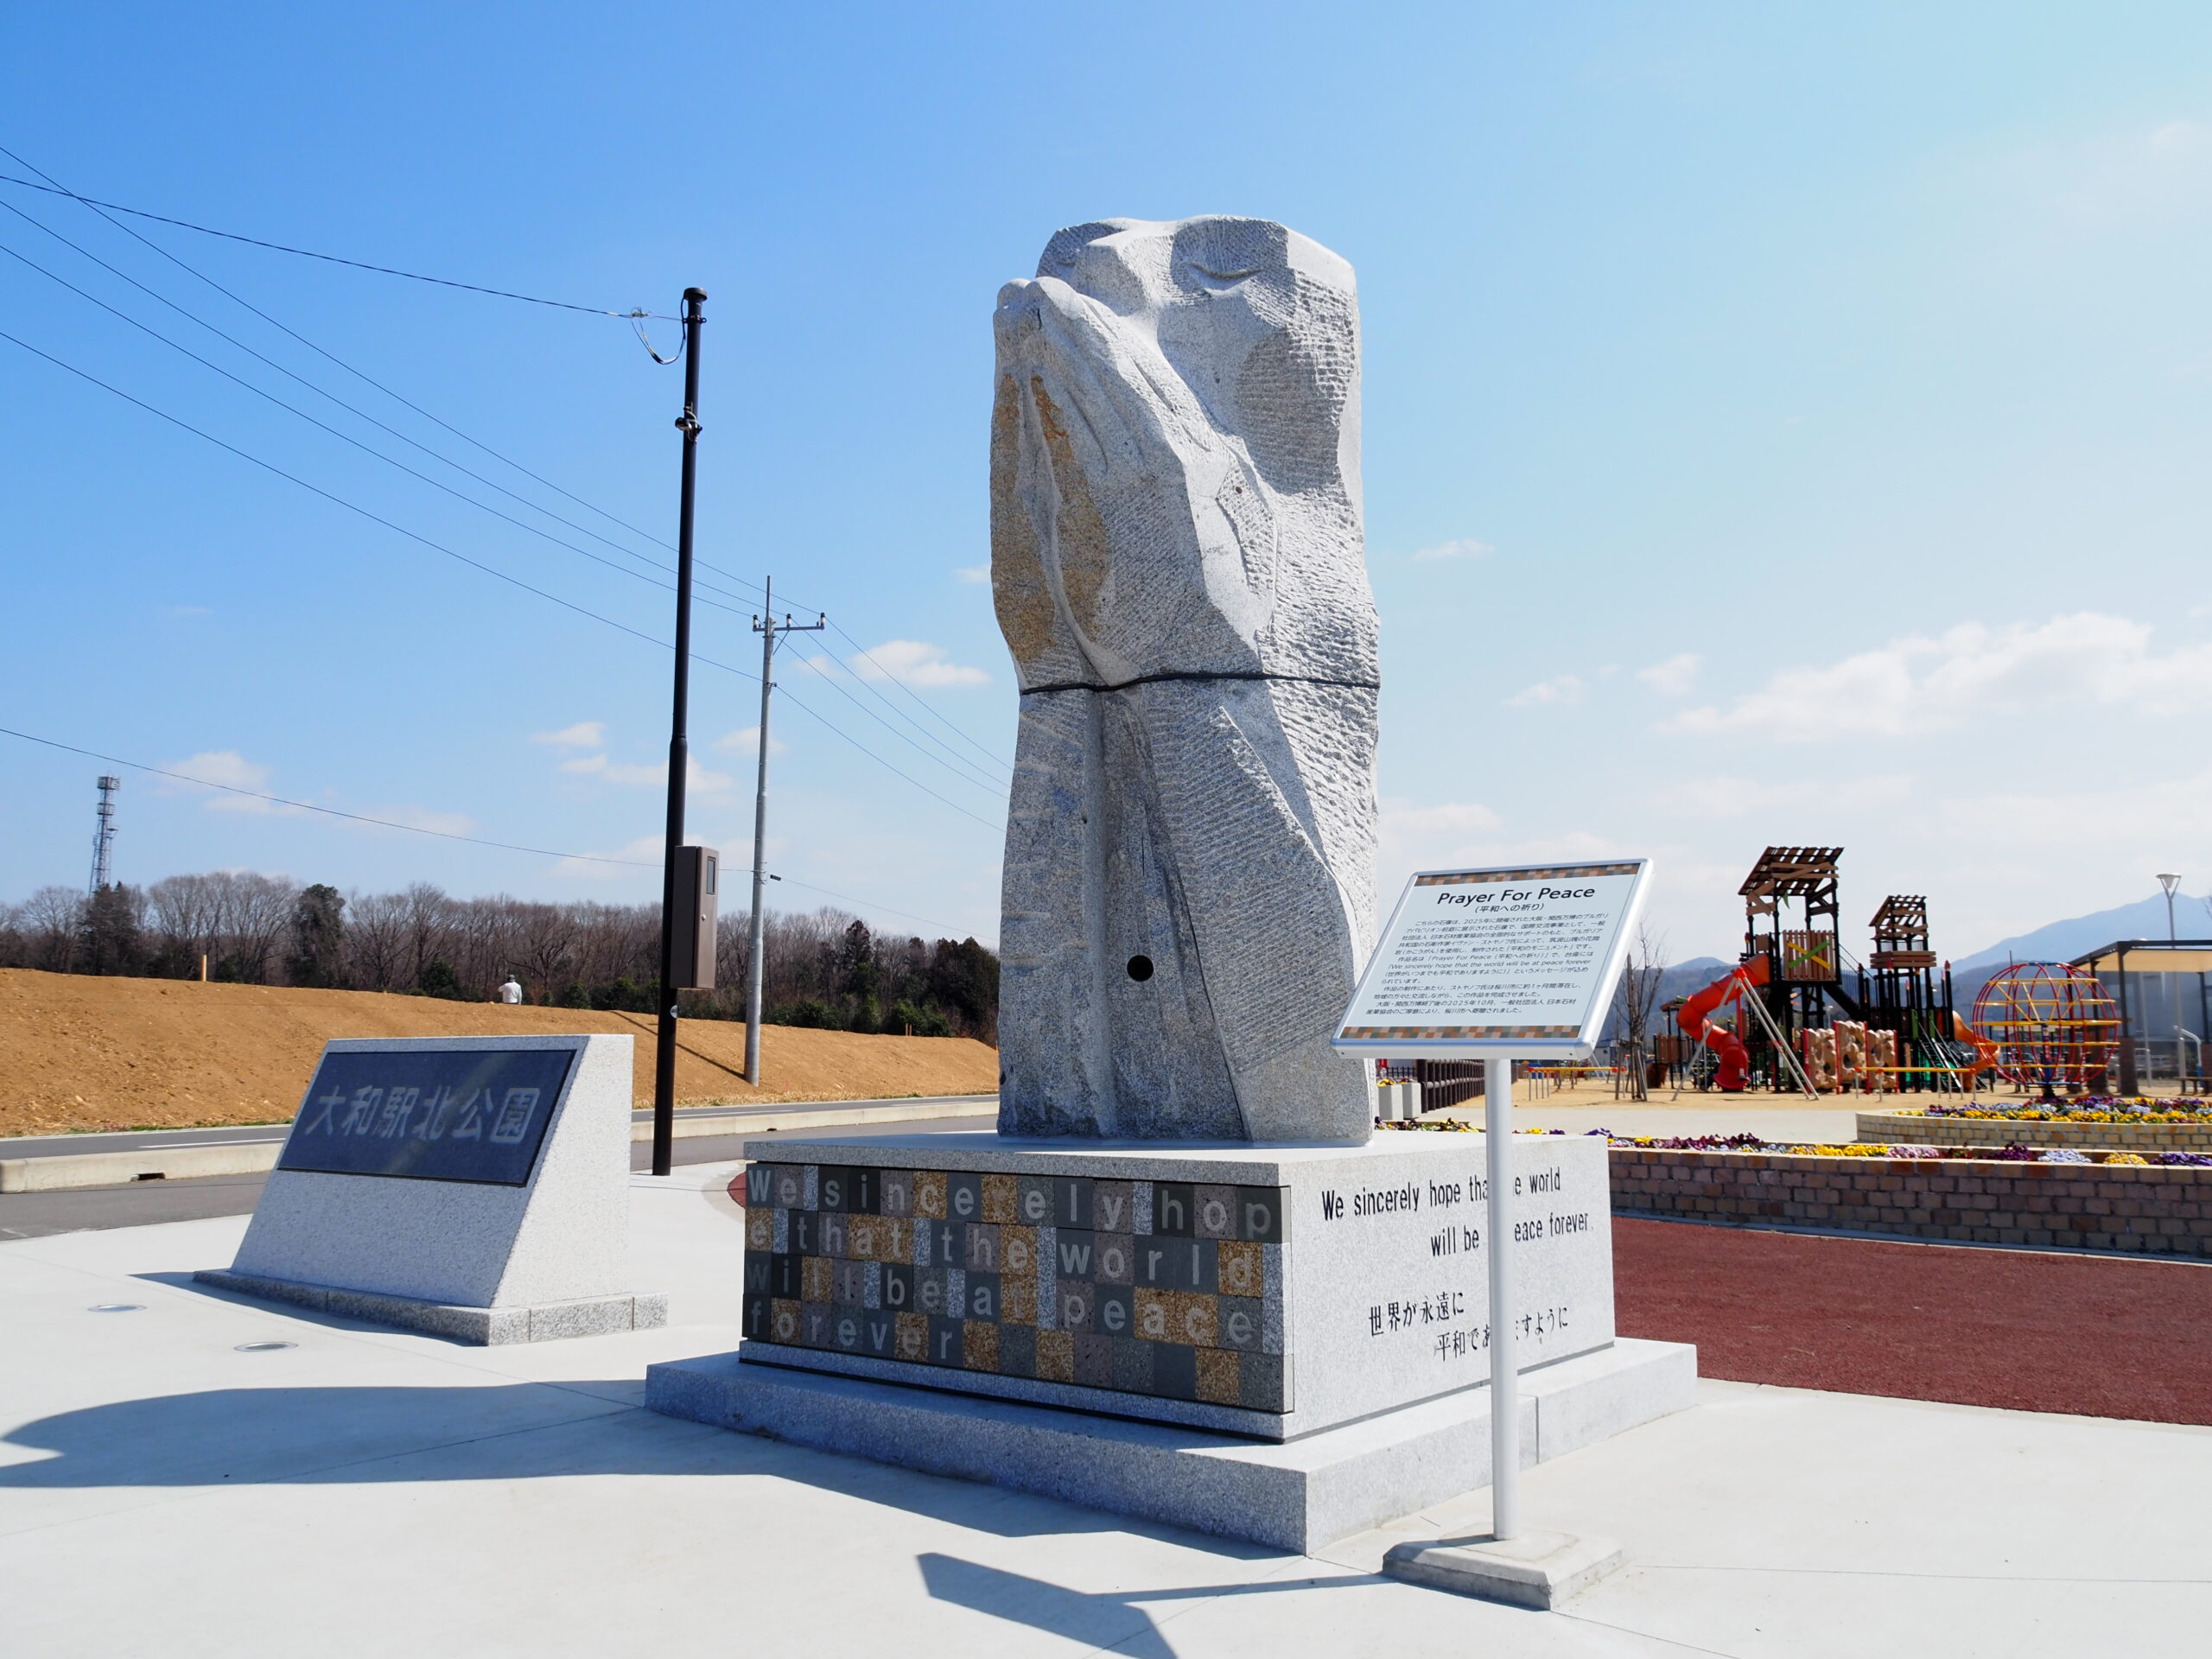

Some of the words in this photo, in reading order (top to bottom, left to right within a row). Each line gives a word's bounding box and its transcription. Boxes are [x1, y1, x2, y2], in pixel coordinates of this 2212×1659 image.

[1436, 892, 1497, 908] Prayer
[1500, 889, 1533, 902] For
[1537, 887, 1596, 900] Peace
[1474, 902, 1545, 914] （平和への祈り）
[305, 1084, 540, 1145] 大和駅北公園
[748, 1169, 797, 1205] We
[824, 1173, 1124, 1230] sincerely
[1161, 1190, 1271, 1238] hop
[1322, 1190, 1344, 1221] We
[1354, 1182, 1420, 1216] sincerely
[1430, 1179, 1460, 1208] hope
[1469, 1174, 1488, 1202] tha
[1529, 1166, 1560, 1194] world
[797, 1216, 901, 1258] that
[941, 1226, 1028, 1268] the
[1060, 1243, 1252, 1288] world
[1431, 1226, 1456, 1257] will
[1464, 1224, 1479, 1251] be
[1514, 1219, 1543, 1242] eace
[747, 1257, 851, 1300] will
[887, 1268, 941, 1307] be
[973, 1284, 1024, 1319] at
[1065, 1295, 1252, 1343] peace
[1369, 1291, 1465, 1337] 世界が永遠に
